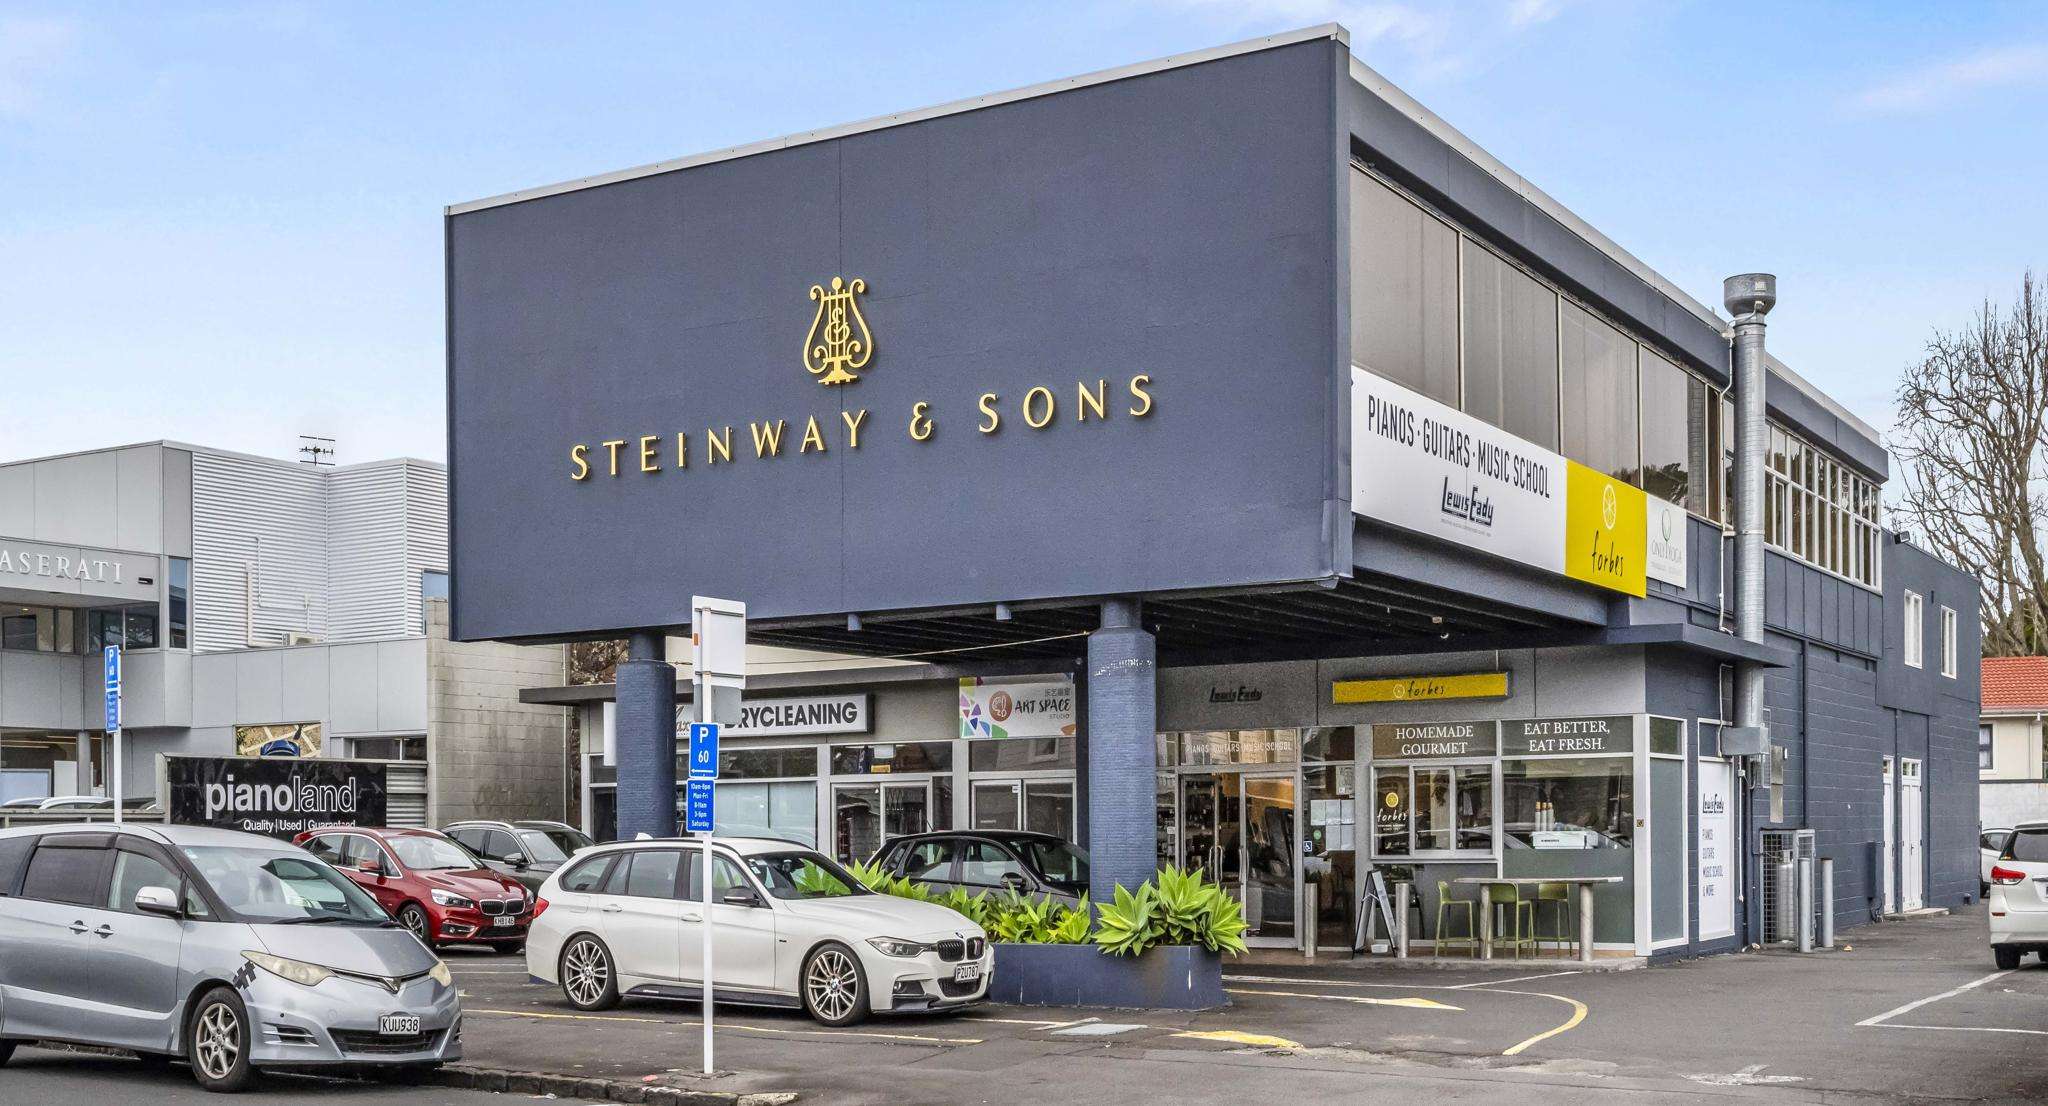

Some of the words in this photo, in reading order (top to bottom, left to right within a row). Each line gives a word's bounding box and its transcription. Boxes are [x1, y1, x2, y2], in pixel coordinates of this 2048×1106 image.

[571, 409, 867, 481] STEINWAY
[909, 402, 934, 440] &
[978, 374, 1153, 434] SONS
[1368, 394, 1414, 447] PIANOS
[1423, 417, 1470, 468] GUITARS
[1478, 439, 1510, 483] MUSIC
[1513, 454, 1550, 499] SCHOOL
[1591, 529, 1624, 577] forbes
[1408, 680, 1444, 697] forbes
[1015, 700, 1036, 713] ART
[1038, 698, 1071, 713] SPACE
[725, 702, 857, 729] RYCLEANING
[699, 726, 709, 744] P
[1395, 725, 1474, 740] HOMEMADE
[1524, 722, 1551, 736] EAT
[1554, 720, 1611, 735] BETTER,
[1401, 742, 1469, 756] GOURMET
[1529, 739, 1556, 752] EAT
[1558, 738, 1606, 751] FRESH.
[698, 750, 710, 764] 60
[205, 774, 356, 820] pianoland
[1377, 808, 1407, 822] forbes
[243, 819, 274, 833] Quality
[279, 819, 302, 831] Used
[382, 1019, 419, 1032] KUU938
